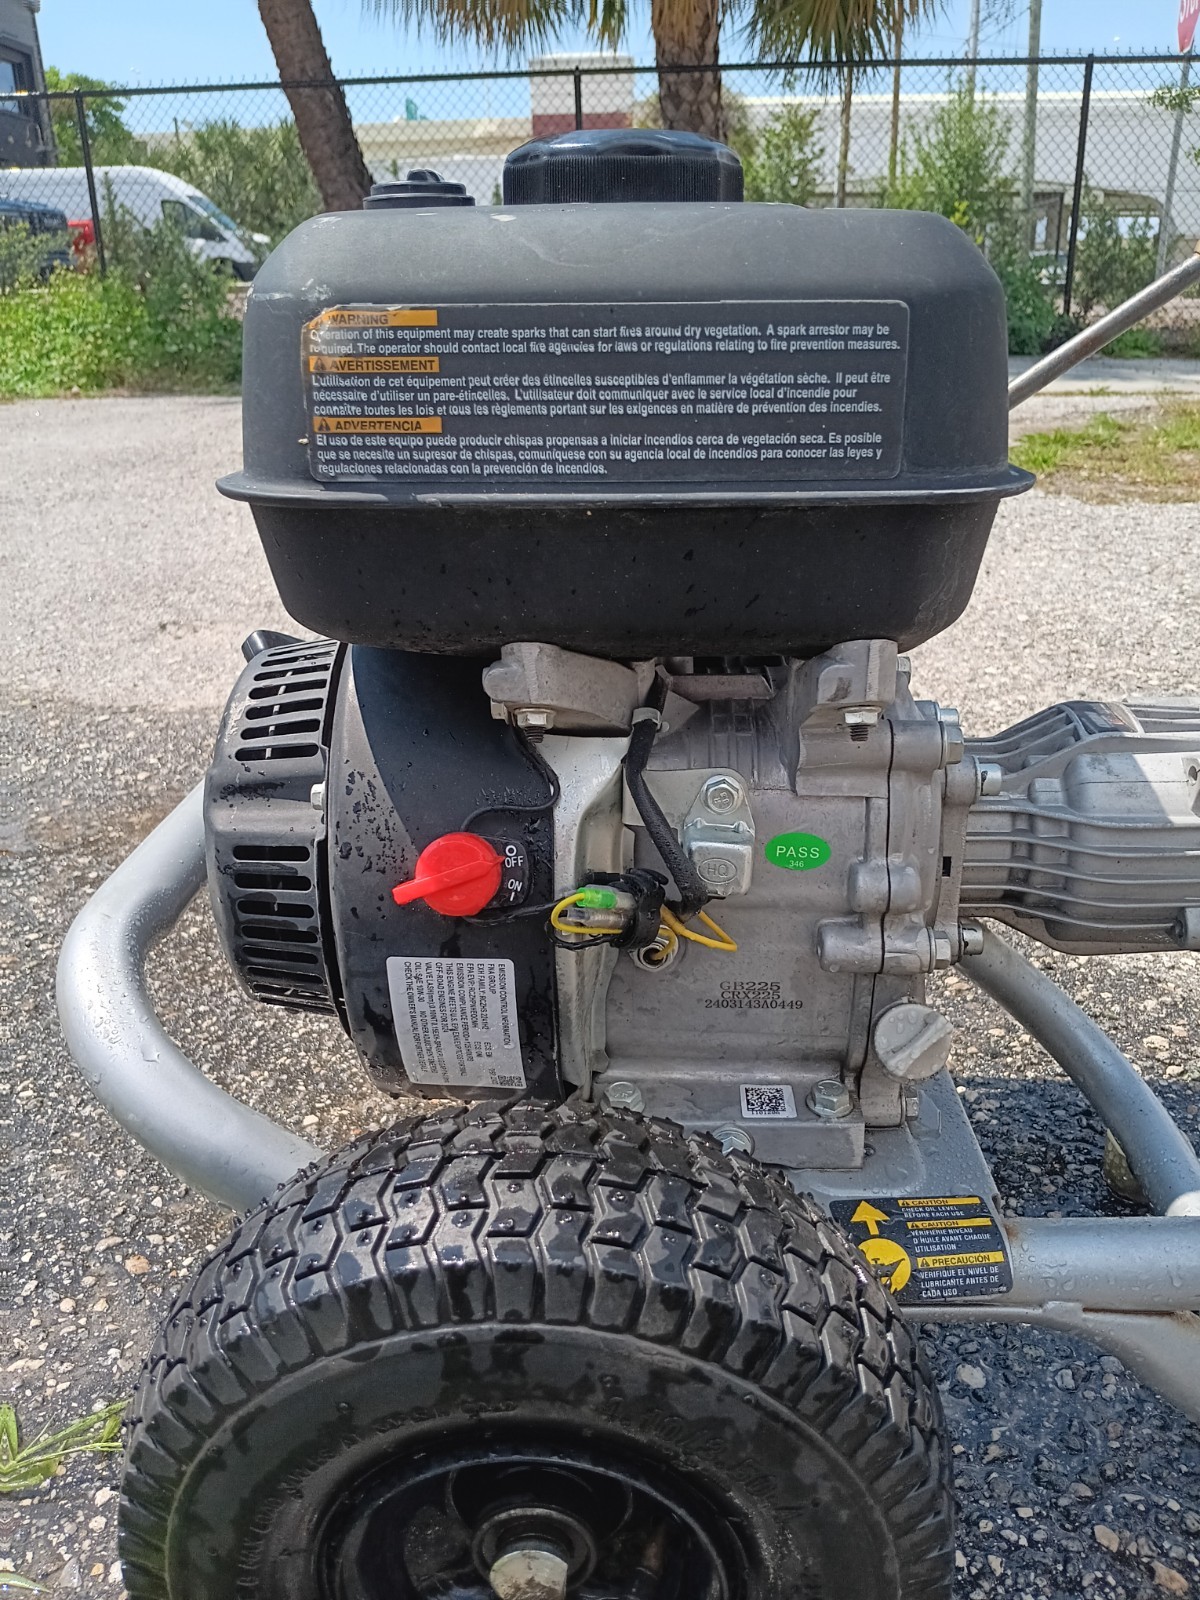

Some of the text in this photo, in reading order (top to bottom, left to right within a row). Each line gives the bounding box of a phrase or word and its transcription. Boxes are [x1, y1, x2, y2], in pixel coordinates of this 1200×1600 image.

[310, 329, 360, 342] Oeration
[374, 329, 394, 339] this
[396, 328, 451, 341] equipment
[453, 330, 475, 340] may
[477, 328, 509, 339] create
[511, 327, 546, 340] sparks
[548, 327, 569, 338] that
[571, 329, 590, 338] can
[593, 327, 617, 338] start
[683, 326, 701, 338] dry
[704, 325, 761, 338] vegetation.
[776, 325, 806, 338] spark
[808, 325, 849, 336] arrestor
[852, 326, 874, 337] may
[378, 343, 421, 355] operator
[423, 342, 459, 353] should
[461, 342, 500, 353] contact
[502, 342, 527, 353] local
[597, 342, 612, 352] for
[654, 341, 712, 353] regulations
[715, 340, 754, 353] relating
[789, 340, 844, 352] prevention
[847, 341, 900, 350] measures.
[330, 359, 435, 371] AVERTISSEMENT
[406, 375, 466, 388] équipement
[467, 375, 491, 387] peut
[492, 375, 520, 386] créer
[594, 374, 659, 387] susceptibles
[740, 373, 794, 386] végétation
[796, 373, 830, 384] sèche.
[844, 373, 868, 385] peut
[870, 373, 890, 383] être
[370, 390, 414, 401] d'utiliser
[514, 390, 574, 400] L'utilisateur
[575, 390, 596, 400] doit
[598, 389, 669, 402] communiquer
[671, 391, 695, 400] avec
[709, 388, 747, 399] service
[749, 388, 774, 399] local
[776, 388, 830, 399] d'incendie
[832, 389, 857, 400] pour
[363, 402, 882, 416] toutes lois règlements portant exigences matière prévention incendies.
[335, 420, 422, 432] ADVERTENCIA
[364, 433, 882, 447] este equipo puede producir chispas propensas iniciar incendios cerca vegetación seca. posible
[352, 447, 873, 461] necesite supresor chispas, comuníquese agencia local incendios para conocer leyes
[317, 463, 607, 475] regulaciones relacionadas prevención incendios.
[776, 846, 820, 858] PASS
[504, 855, 524, 868] OFF
[789, 860, 804, 868] 346
[706, 863, 730, 877] HQ
[507, 879, 523, 892] ON
[404, 961, 413, 980] CHECK
[477, 963, 485, 974] EXH
[435, 962, 445, 989] OFF-ROAD
[498, 964, 507, 990] EMISSION
[488, 975, 497, 994] GROUP
[719, 981, 781, 991] GB225
[720, 990, 781, 1000] CRX225
[499, 990, 508, 1014] CONTROL
[704, 1000, 803, 1009] 2403143A0449
[912, 1236, 940, 1244] D'HUILE
[915, 1244, 957, 1253] UTILISATION
[932, 1254, 991, 1266] PRECAUCIÓN
[920, 1269, 956, 1279] VERIFIQUE
[957, 1268, 966, 1276] EL
[968, 1267, 989, 1275] NIVEL
[921, 1275, 999, 1288] LUBRICANTE ANTES DE
[922, 1288, 957, 1298] CADA USO
